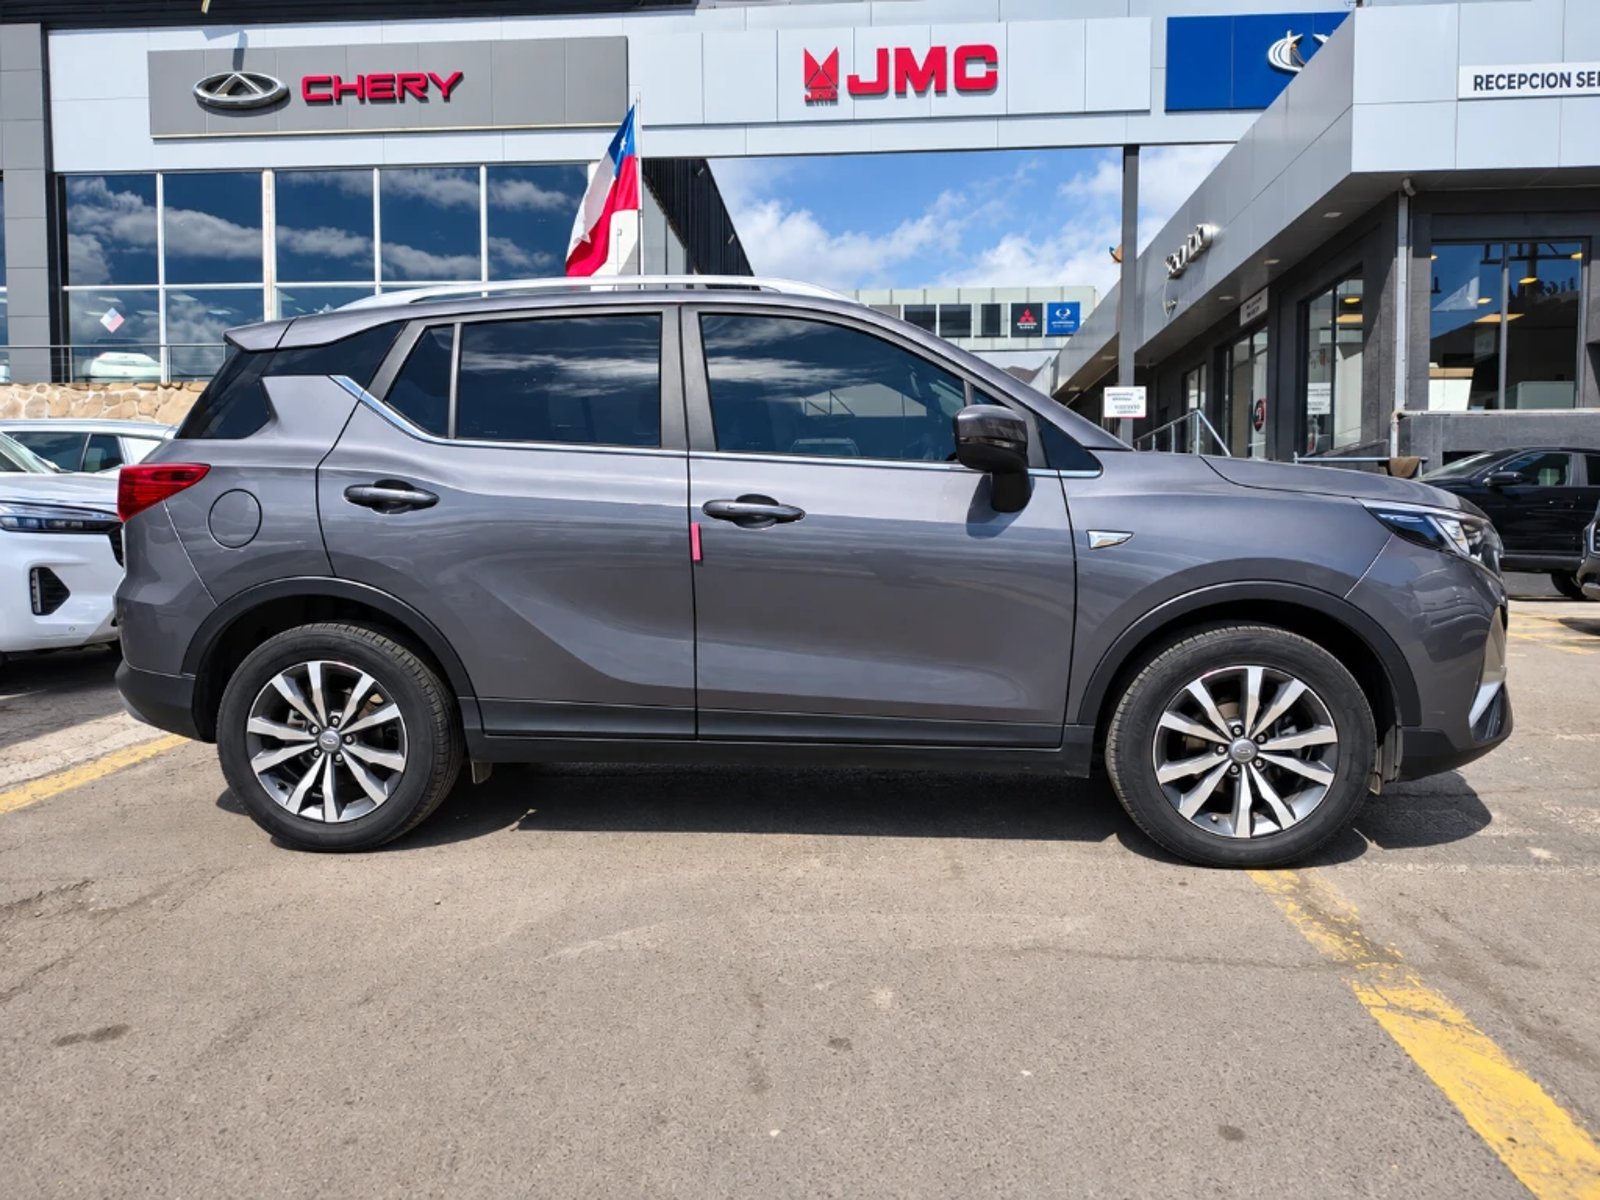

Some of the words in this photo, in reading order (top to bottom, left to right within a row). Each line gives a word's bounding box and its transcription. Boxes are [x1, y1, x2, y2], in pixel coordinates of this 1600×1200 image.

[847, 44, 999, 96] JMC
[1473, 72, 1572, 91] RECEPCION
[1576, 71, 1600, 88] SE
[302, 72, 464, 102] CHERY
